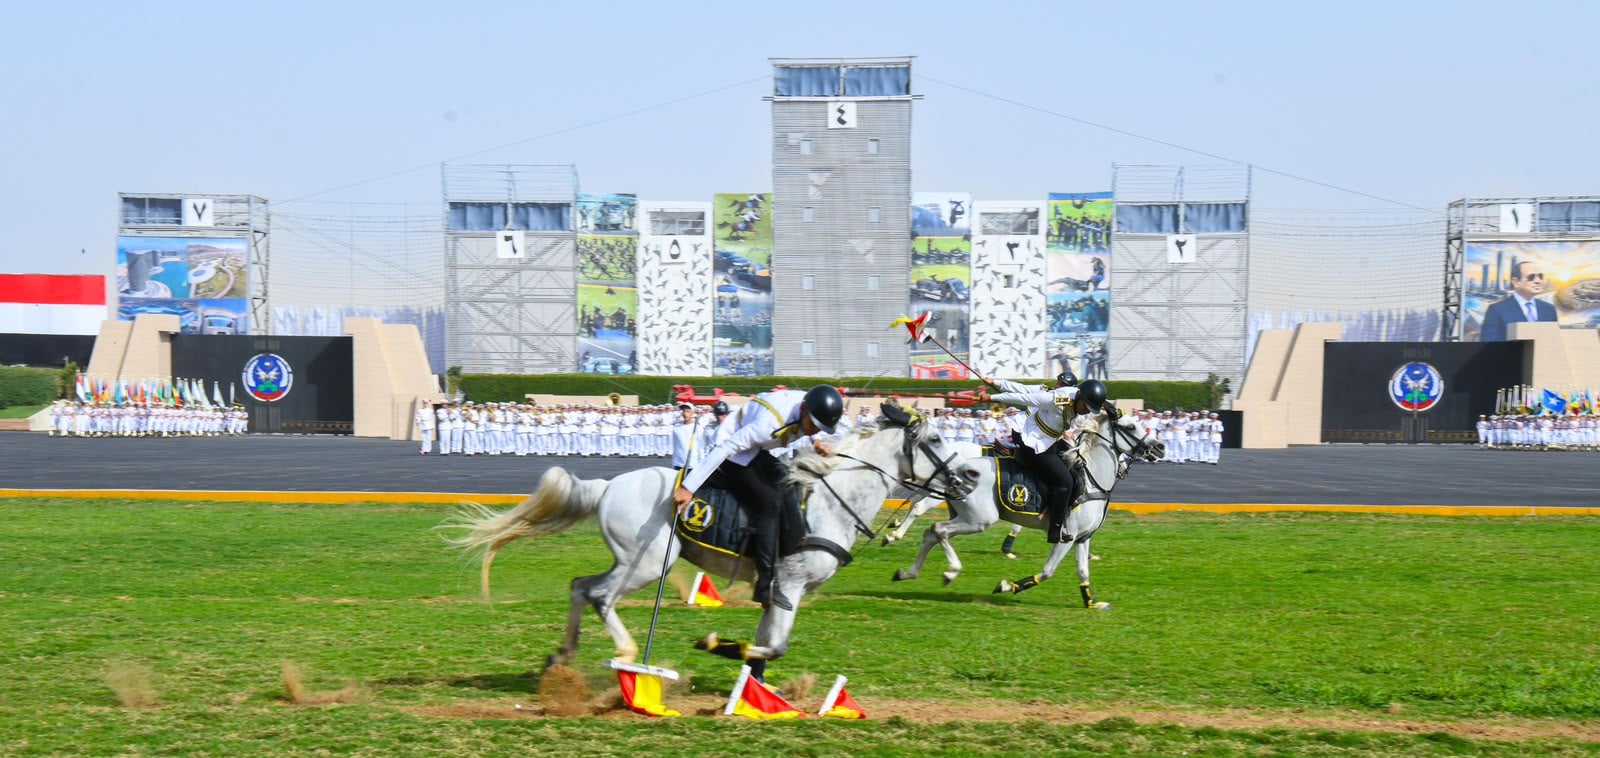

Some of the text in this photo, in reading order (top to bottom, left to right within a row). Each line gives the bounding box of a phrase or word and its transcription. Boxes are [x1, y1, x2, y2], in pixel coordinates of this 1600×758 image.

[837, 104, 847, 125] ٤
[193, 202, 206, 221] ٧
[1511, 208, 1519, 226] ١
[504, 235, 517, 254] ٦
[669, 239, 680, 260] ٥
[1006, 241, 1020, 260] ٣
[1175, 239, 1187, 258] ٢
